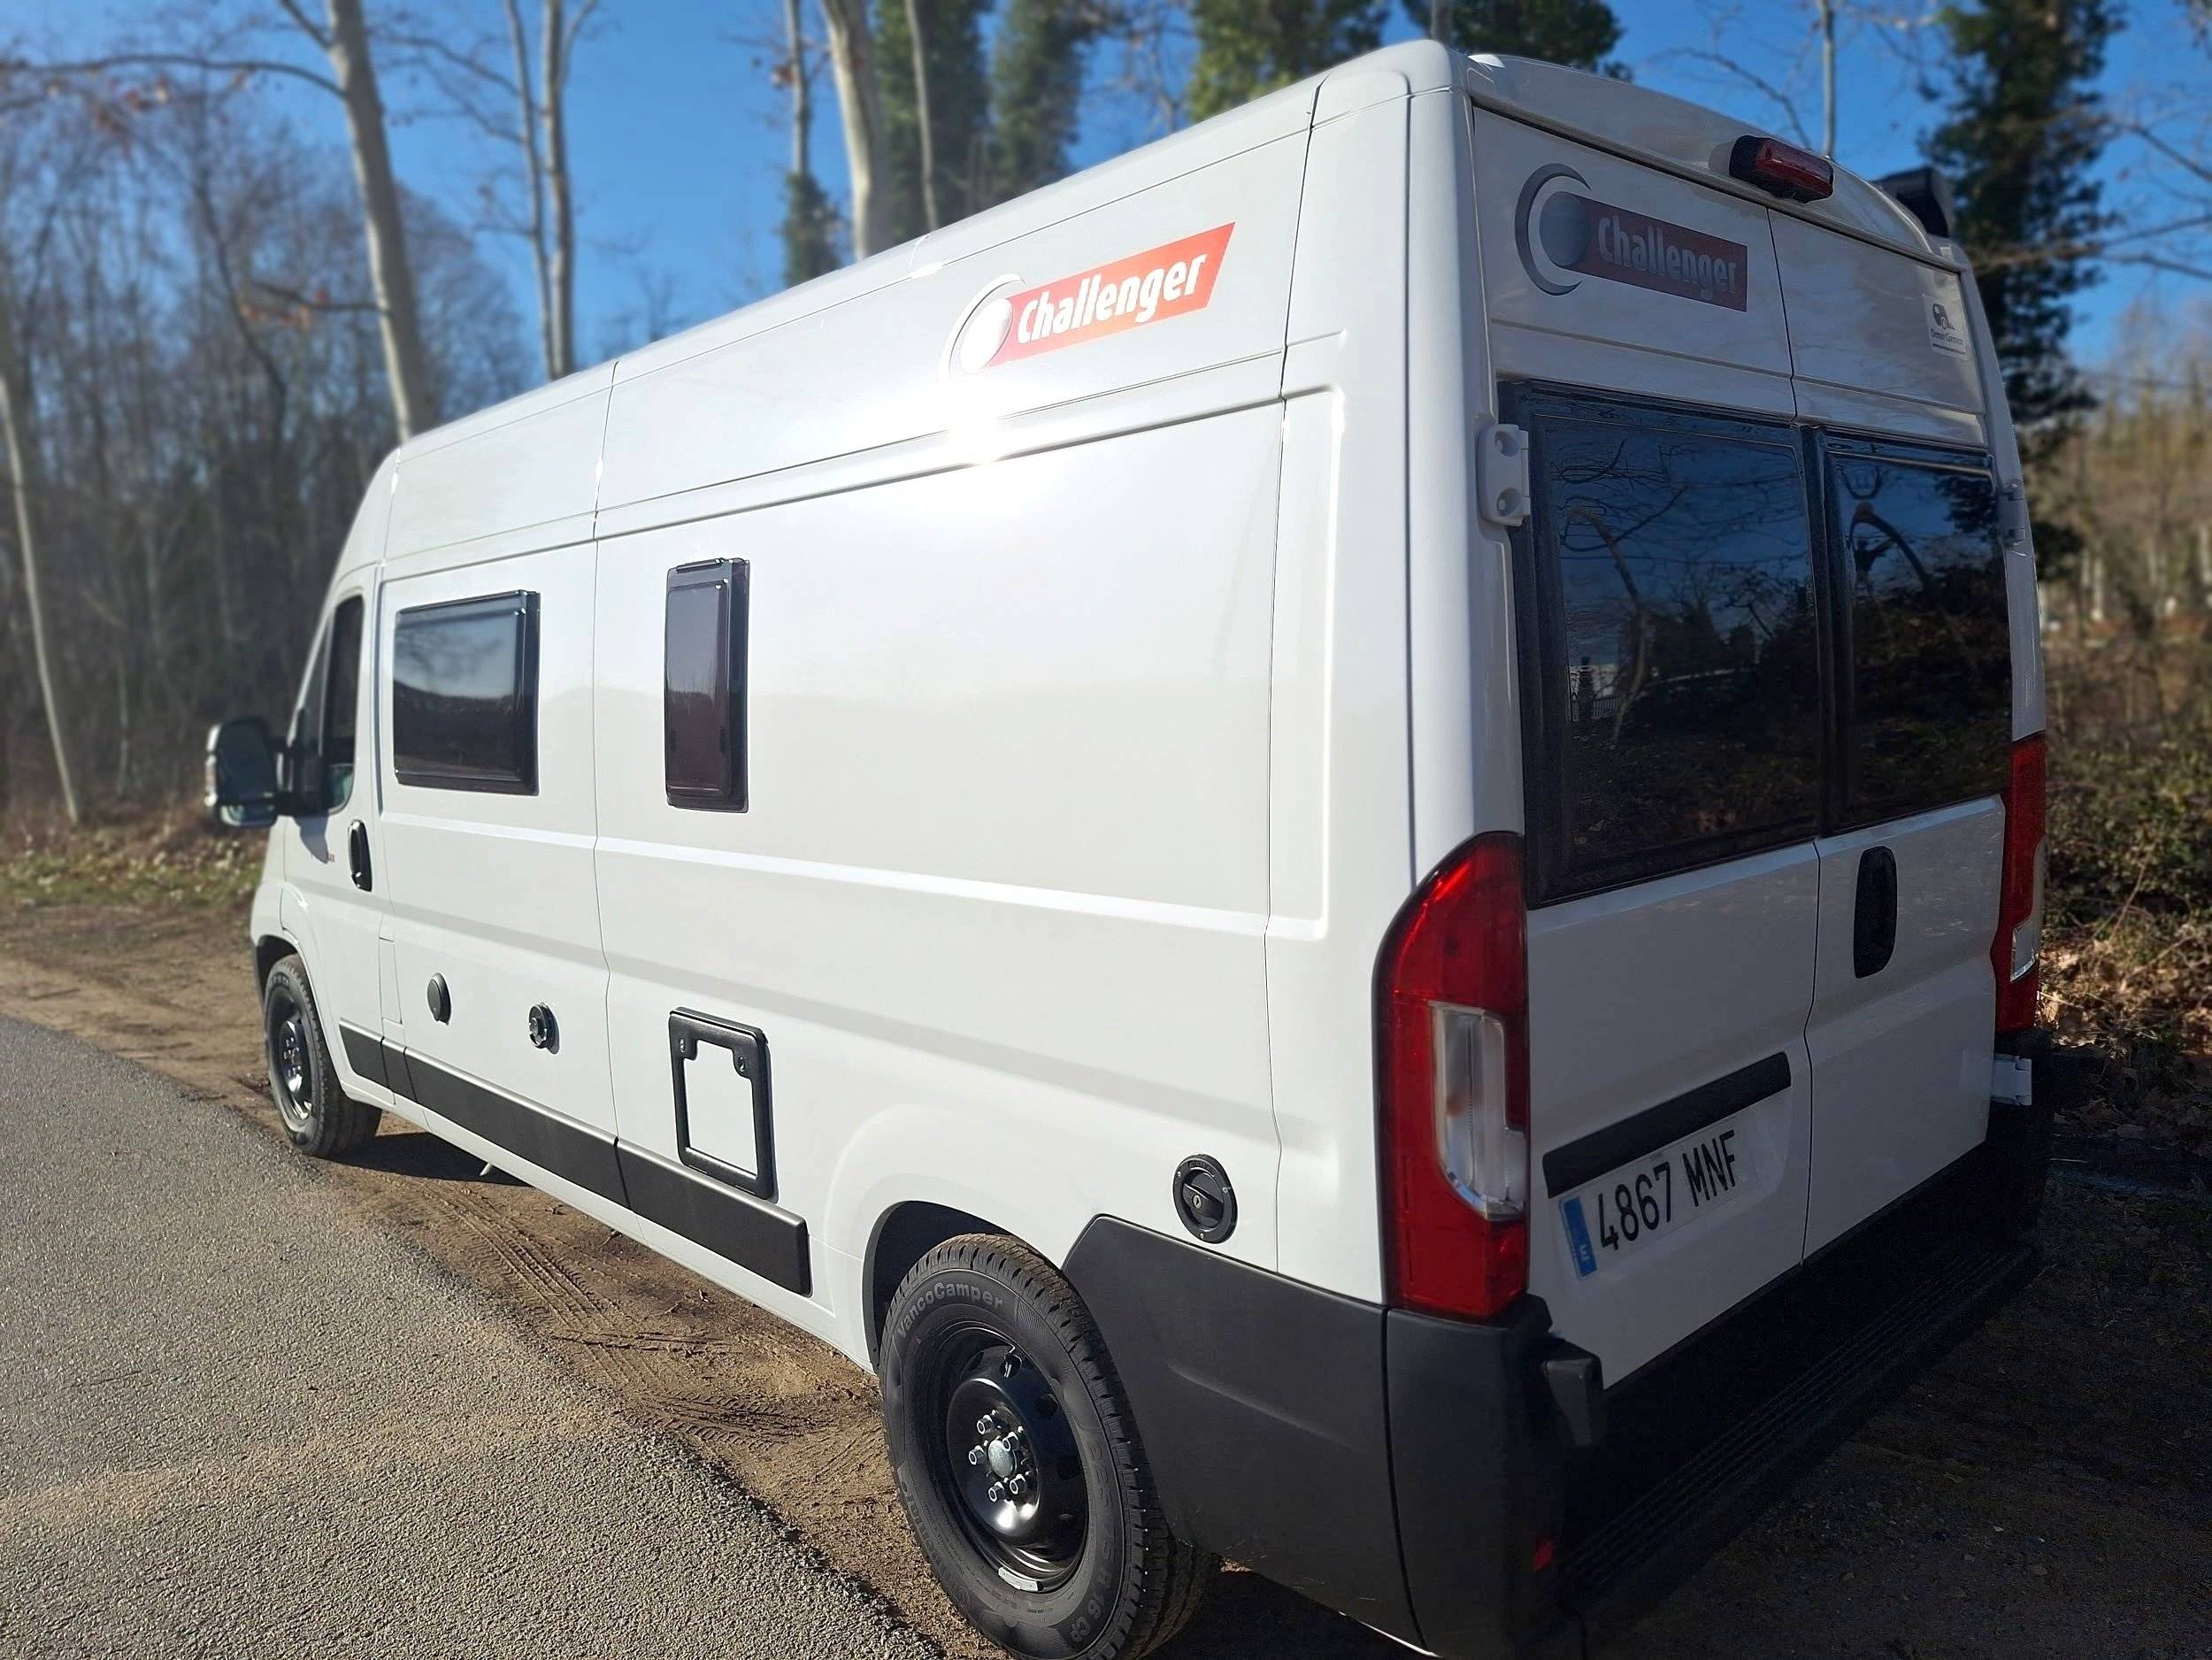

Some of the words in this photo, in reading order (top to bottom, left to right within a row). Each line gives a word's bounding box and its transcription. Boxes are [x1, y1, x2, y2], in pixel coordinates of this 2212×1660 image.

[1018, 253, 1208, 344] Challenger
[1597, 215, 1739, 301] Challenger
[1597, 1160, 1672, 1251] 4867
[1682, 1128, 1737, 1208] MNF
[1578, 1244, 1591, 1262] E
[897, 1281, 1005, 1339] VancoCamper
